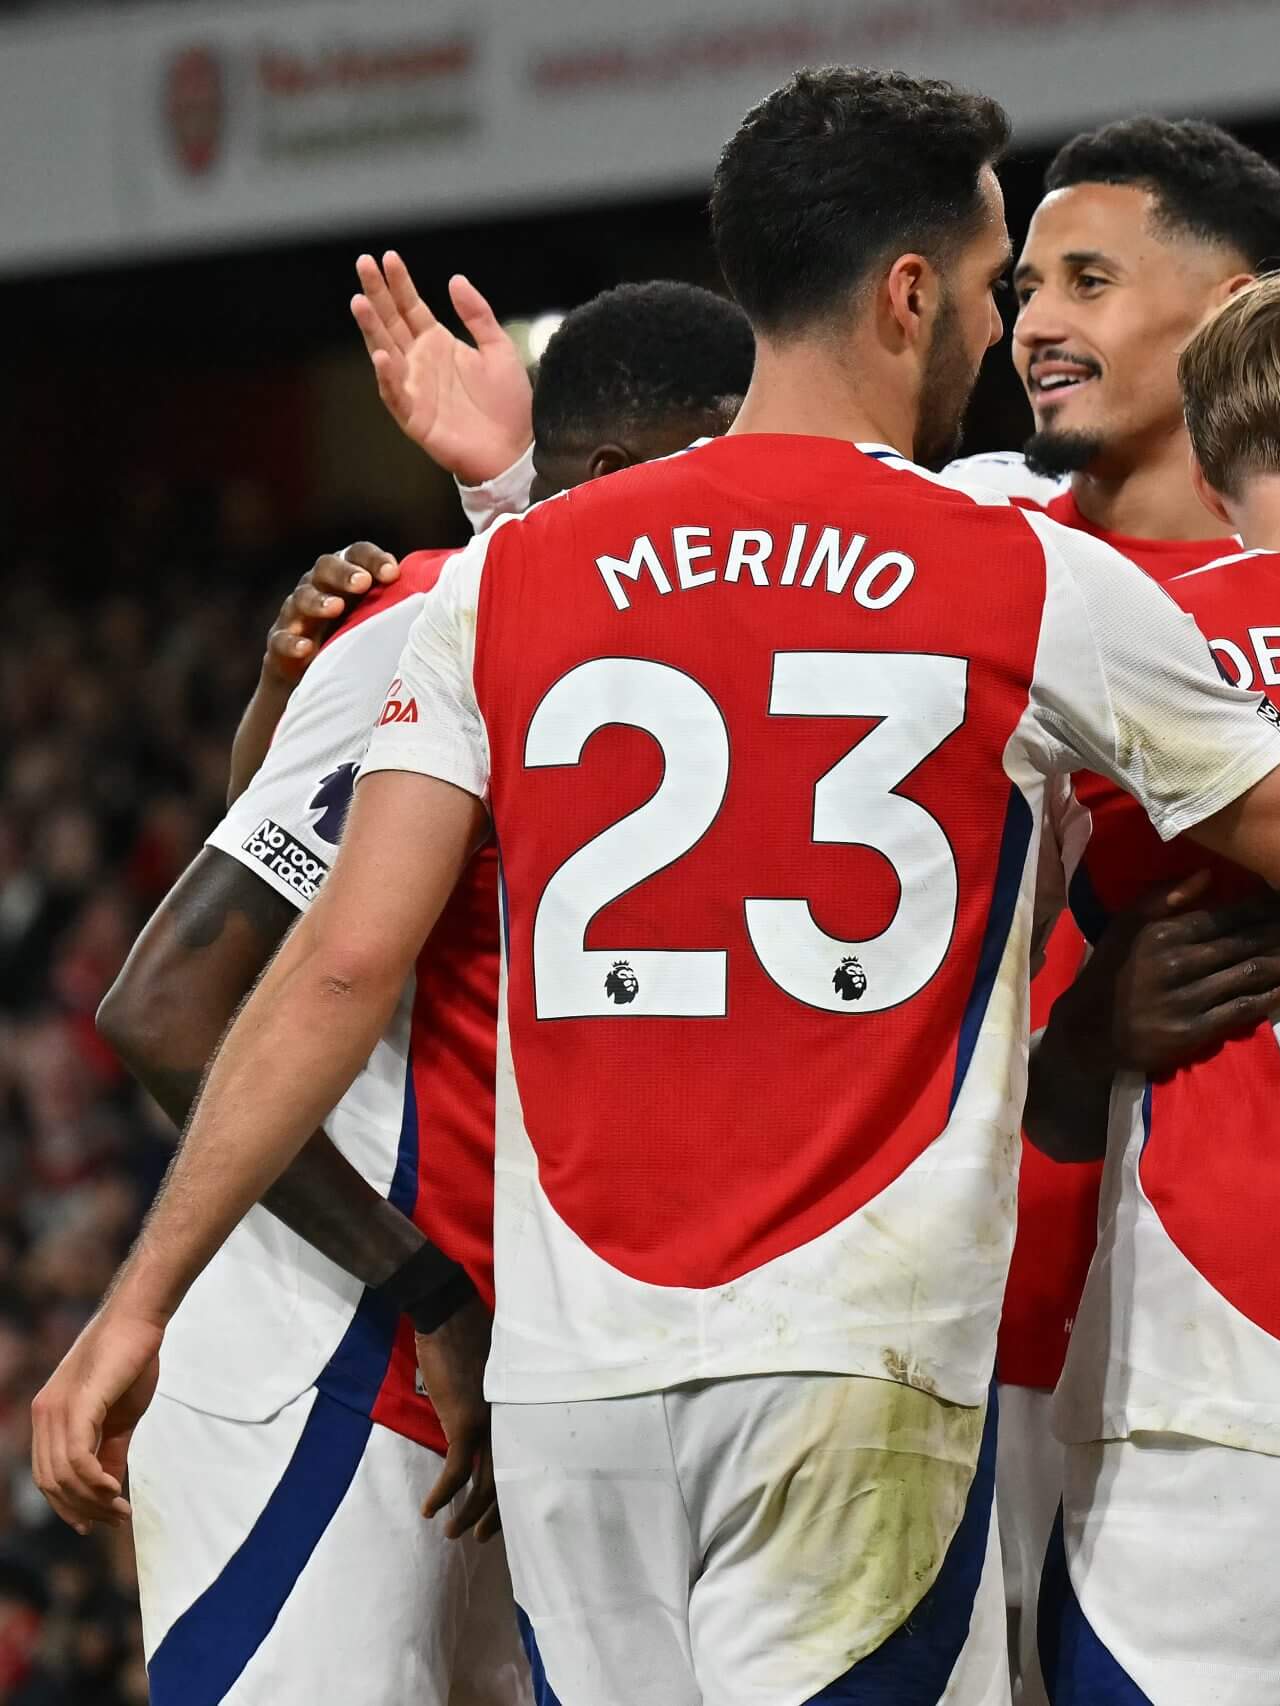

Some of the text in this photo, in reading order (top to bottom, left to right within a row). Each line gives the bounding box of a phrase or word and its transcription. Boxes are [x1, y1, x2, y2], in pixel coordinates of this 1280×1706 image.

[595, 523, 916, 611] MERINO
[242, 831, 319, 900] for racis
[254, 819, 286, 848] No
[523, 650, 970, 1021] 23
